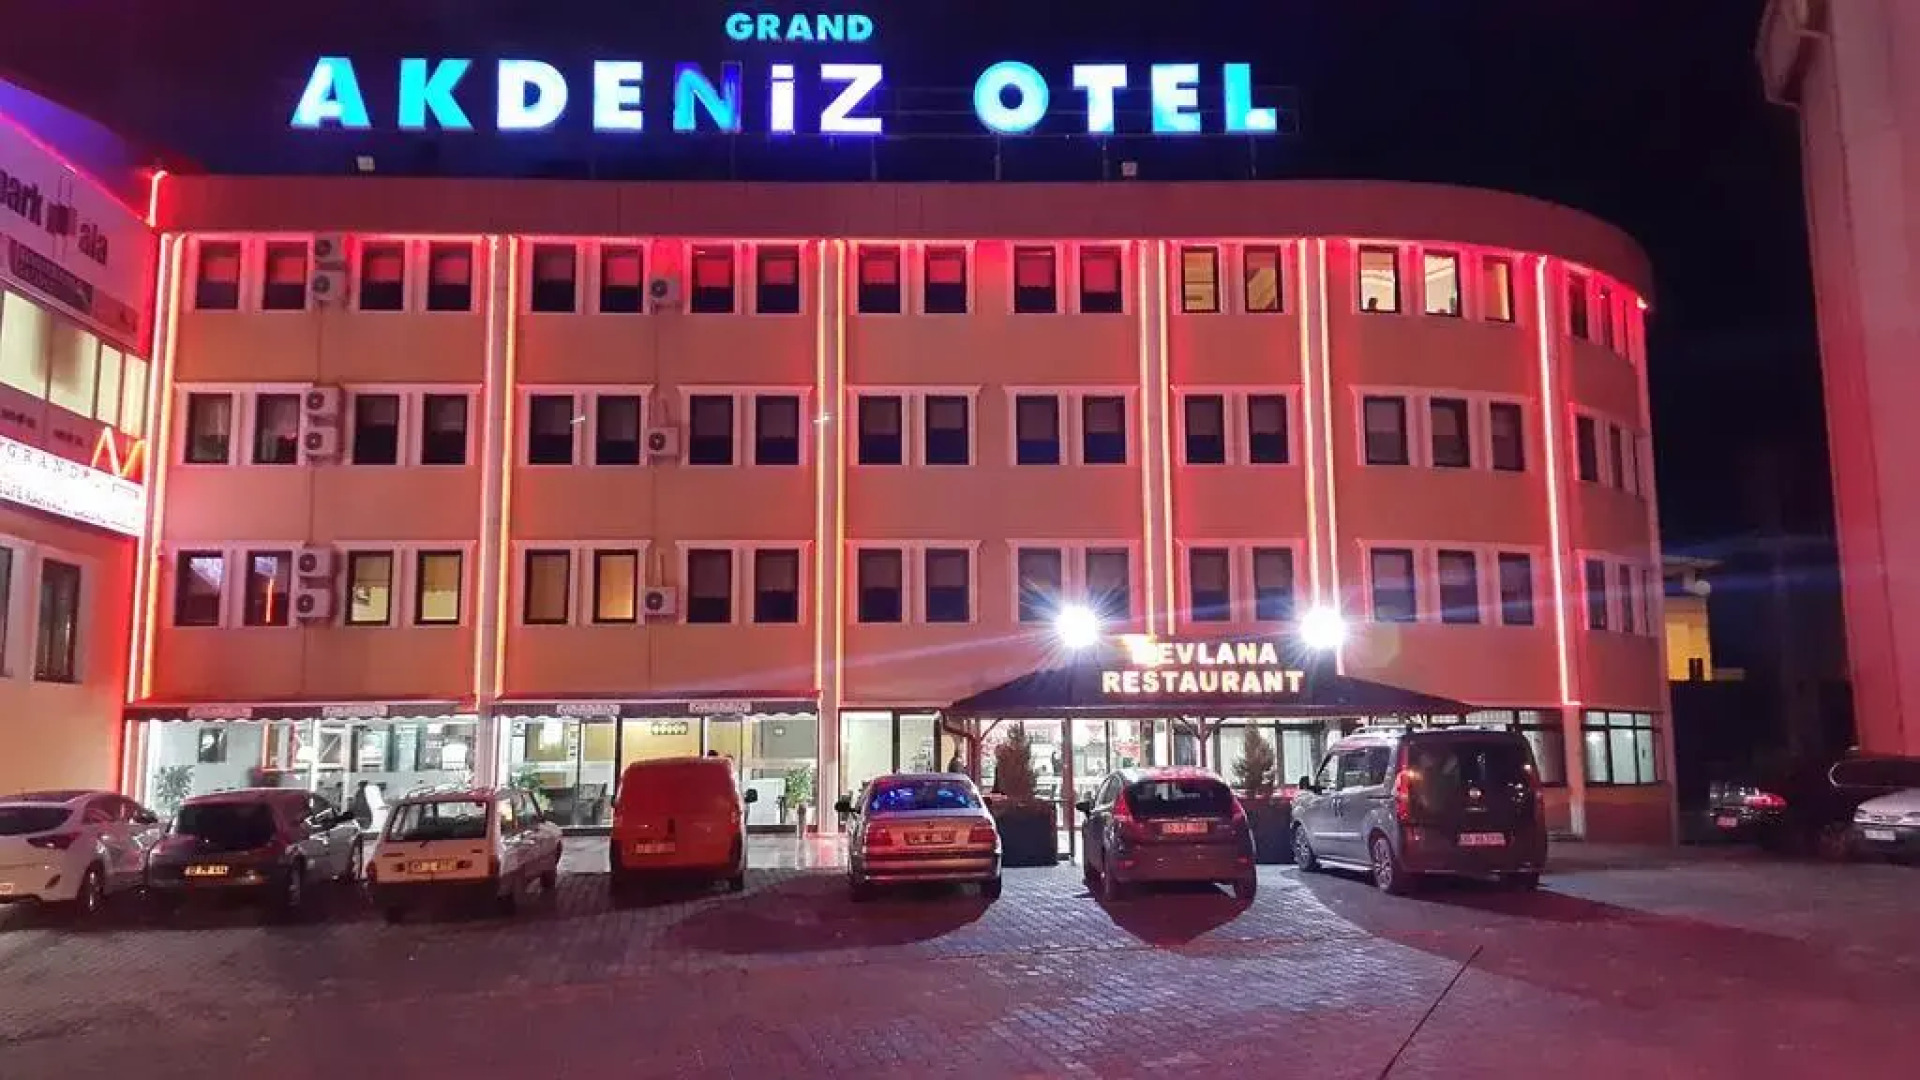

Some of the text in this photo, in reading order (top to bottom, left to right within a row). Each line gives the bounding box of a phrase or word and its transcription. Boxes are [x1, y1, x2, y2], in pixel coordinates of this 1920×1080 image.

[725, 13, 873, 41] GRAND
[974, 61, 1277, 134] OTEL
[1131, 642, 1279, 665] EVLANA
[1101, 670, 1305, 693] RESTAURANT
